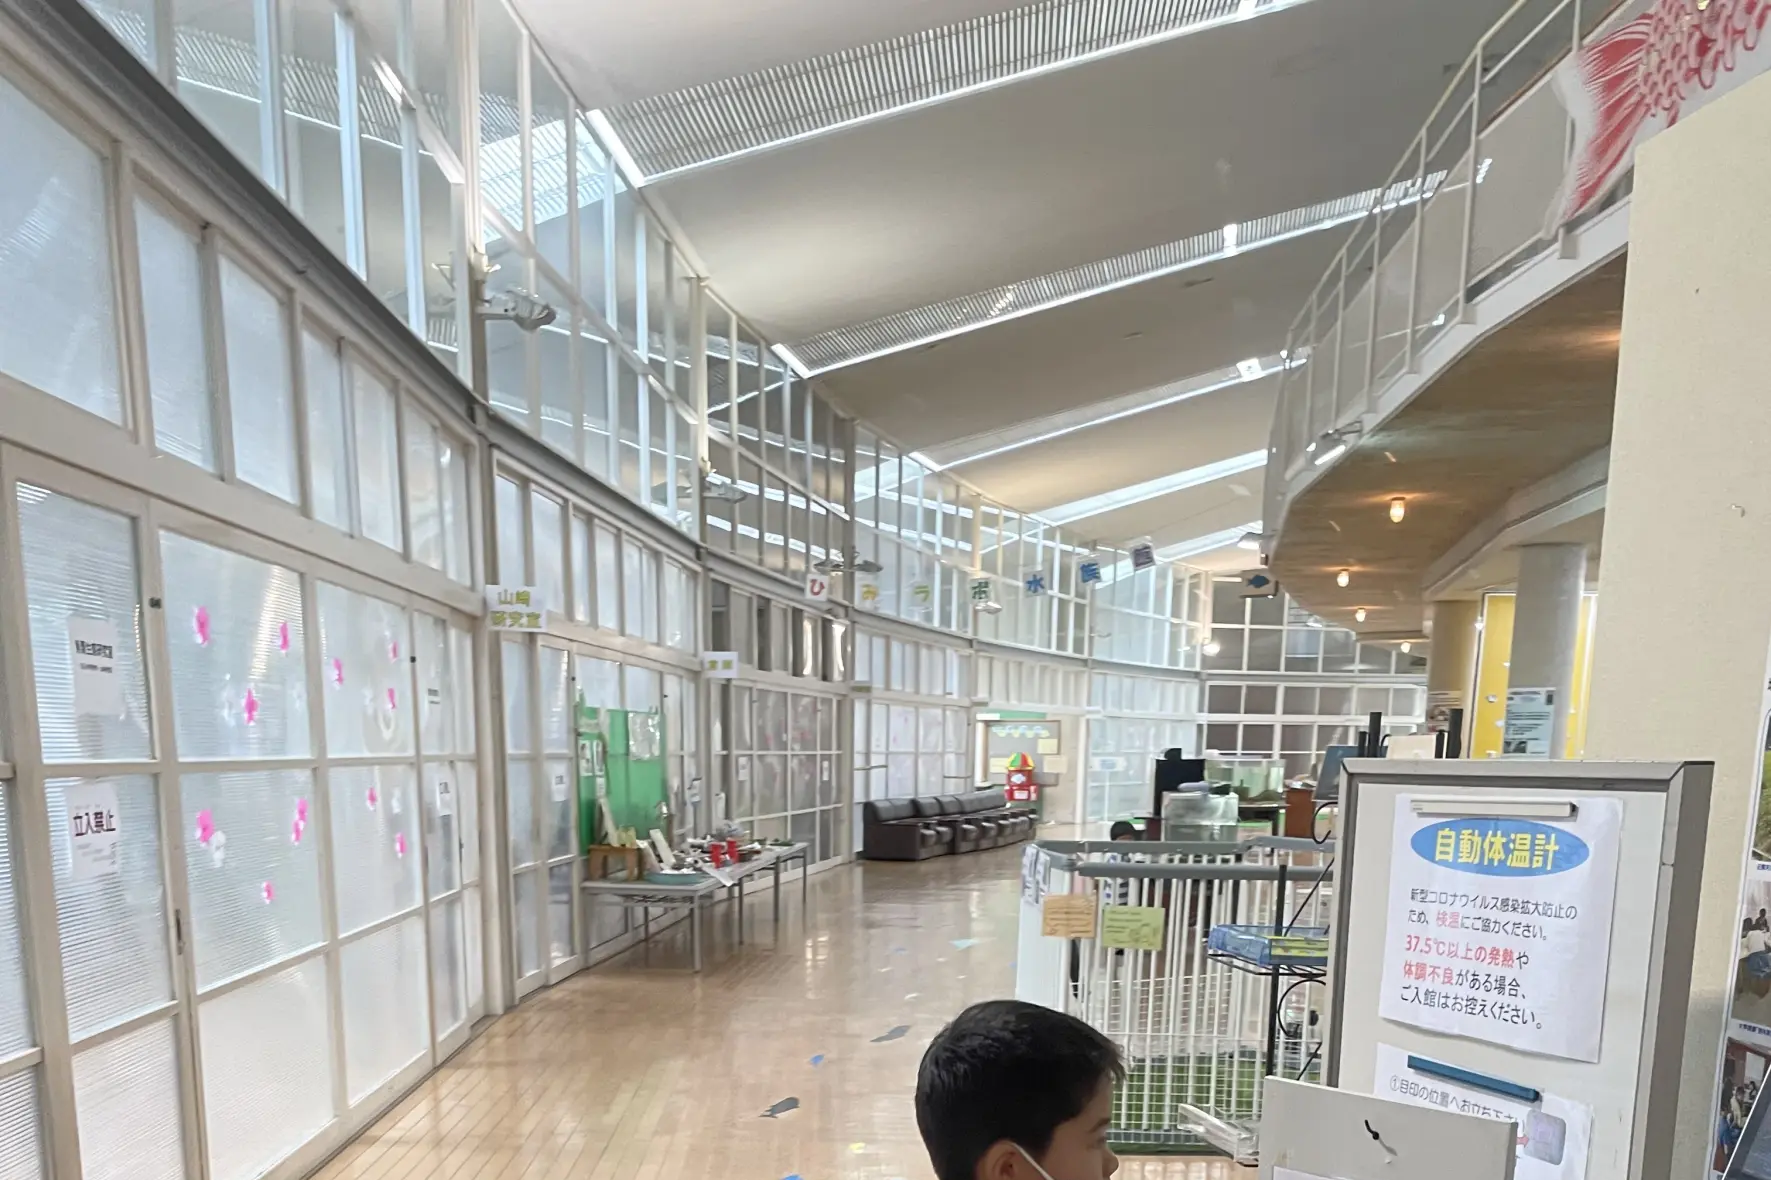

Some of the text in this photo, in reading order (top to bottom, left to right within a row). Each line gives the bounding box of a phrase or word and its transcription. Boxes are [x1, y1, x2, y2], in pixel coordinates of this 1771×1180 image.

[1434, 827, 1560, 871] 自動体温計
[1410, 887, 1578, 921] 新型コロナウイルス感染拡大防止の
[1407, 908, 1549, 942] ため、検温にご協力ください。
[1405, 934, 1530, 970] 37.5℃以上の発熱や
[1403, 959, 1527, 1000] 体調不良がある場合、
[1400, 984, 1542, 1030] ご入館はお控えください。
